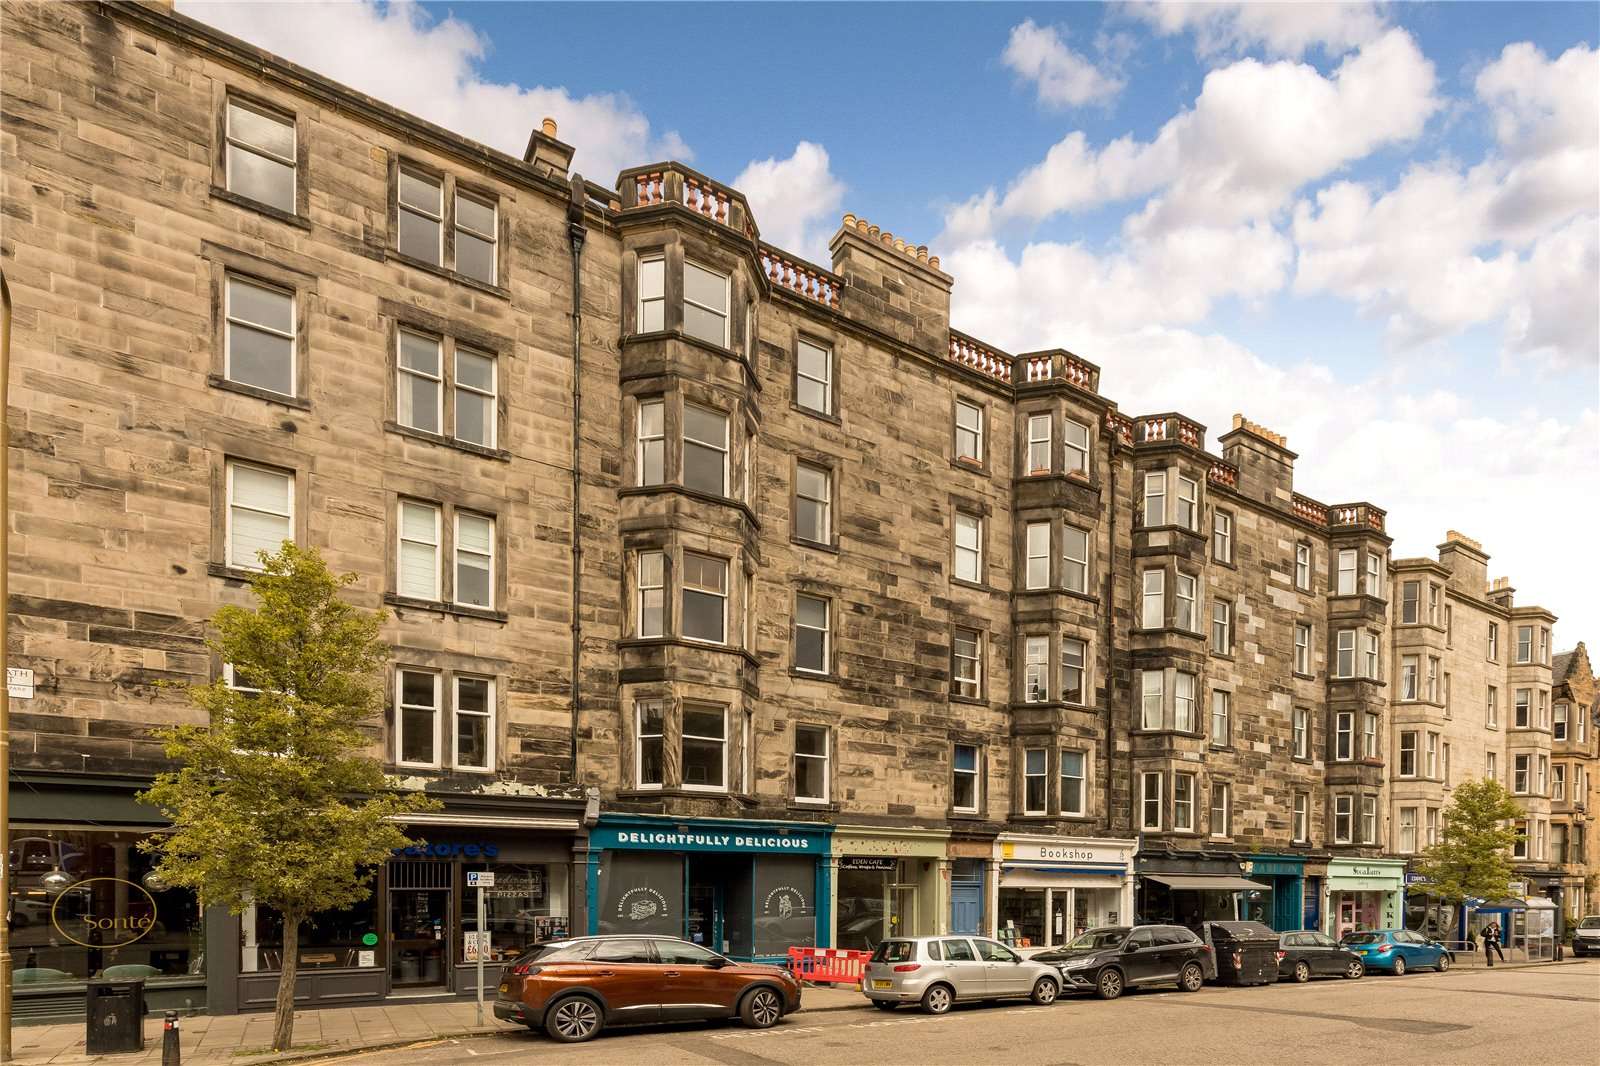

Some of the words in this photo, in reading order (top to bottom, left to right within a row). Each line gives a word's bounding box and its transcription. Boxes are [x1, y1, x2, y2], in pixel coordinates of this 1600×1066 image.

[618, 832, 730, 846] DELIGHTFULLY
[735, 837, 809, 848] DELICIOUS
[1040, 847, 1093, 860] Bookshop
[83, 913, 151, 930] Sonté
